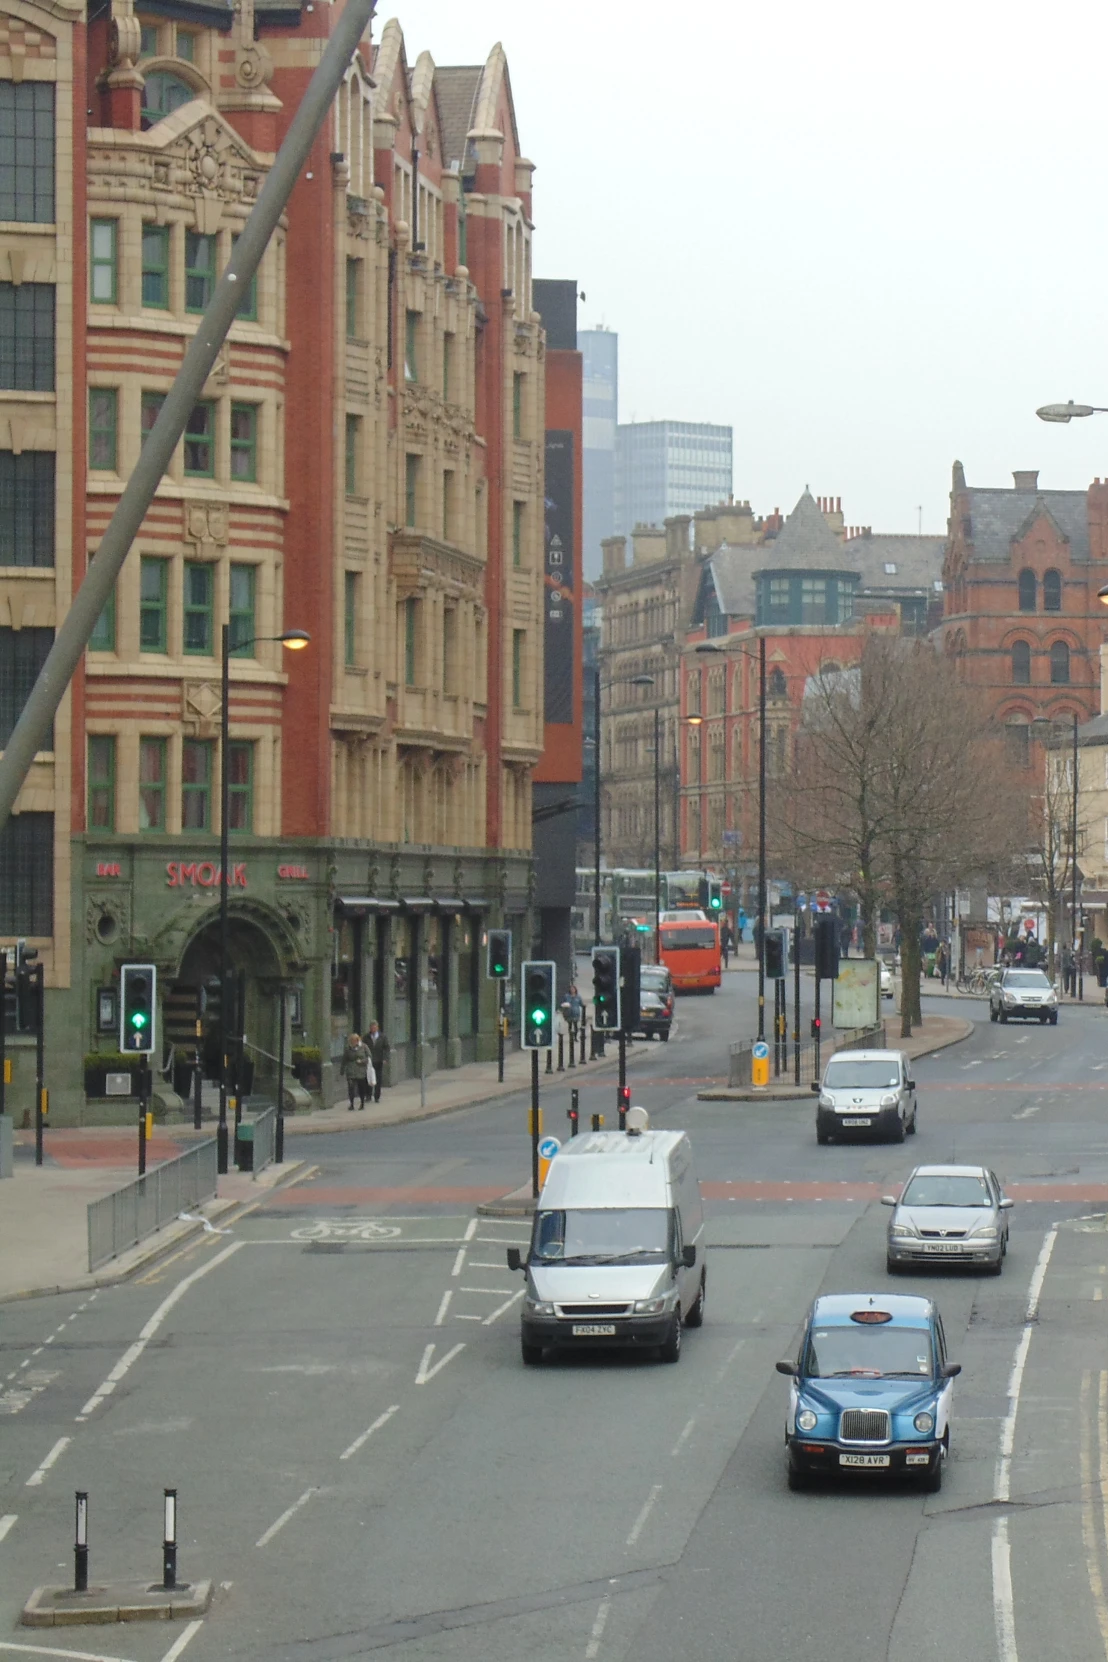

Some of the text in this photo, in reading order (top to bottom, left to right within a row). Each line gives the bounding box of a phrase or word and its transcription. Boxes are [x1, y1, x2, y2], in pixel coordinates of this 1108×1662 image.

[97, 863, 121, 877] BAR
[166, 861, 248, 888] SMOAK
[278, 864, 309, 879] GRILL
[845, 1456, 885, 1464] X128 AVR
